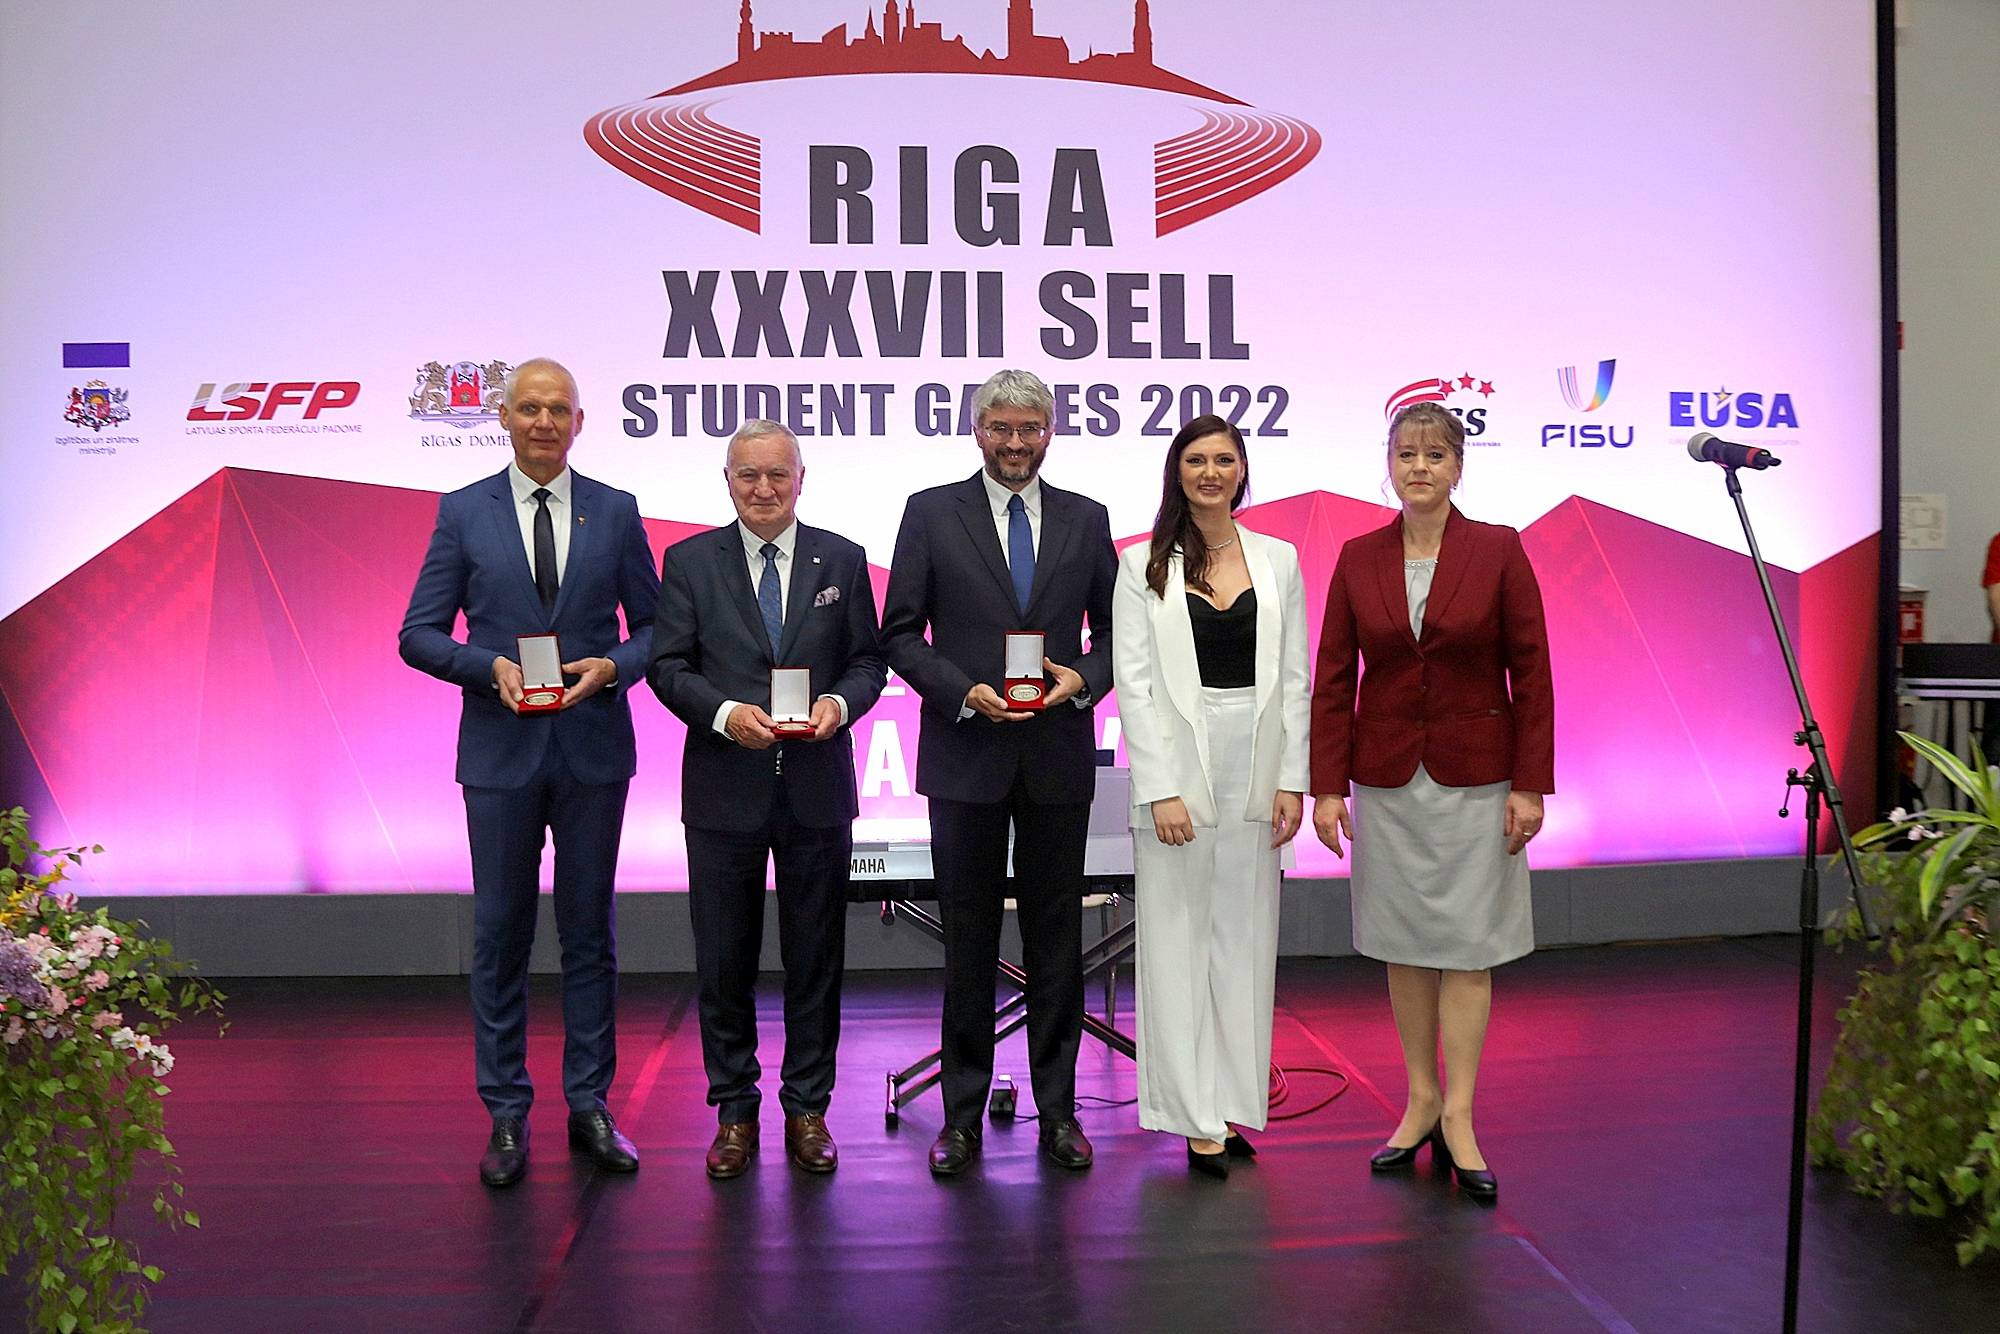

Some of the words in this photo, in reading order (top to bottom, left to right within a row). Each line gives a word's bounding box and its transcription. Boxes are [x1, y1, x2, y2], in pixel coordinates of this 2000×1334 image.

[809, 144, 1113, 247] RIGA
[662, 270, 1004, 358] XXXVII
[1038, 270, 1250, 360] SELL
[186, 381, 362, 422] LSFP
[622, 383, 895, 438] STUDENT
[915, 383, 1121, 437] GAES
[1140, 384, 1290, 437] 2022
[1669, 391, 1800, 429] EUSA
[229, 426, 264, 435] SPORTA
[322, 424, 363, 433] PADOME
[469, 434, 512, 447] DOME
[1541, 424, 1634, 448] FISU
[850, 858, 886, 873] MAHA
